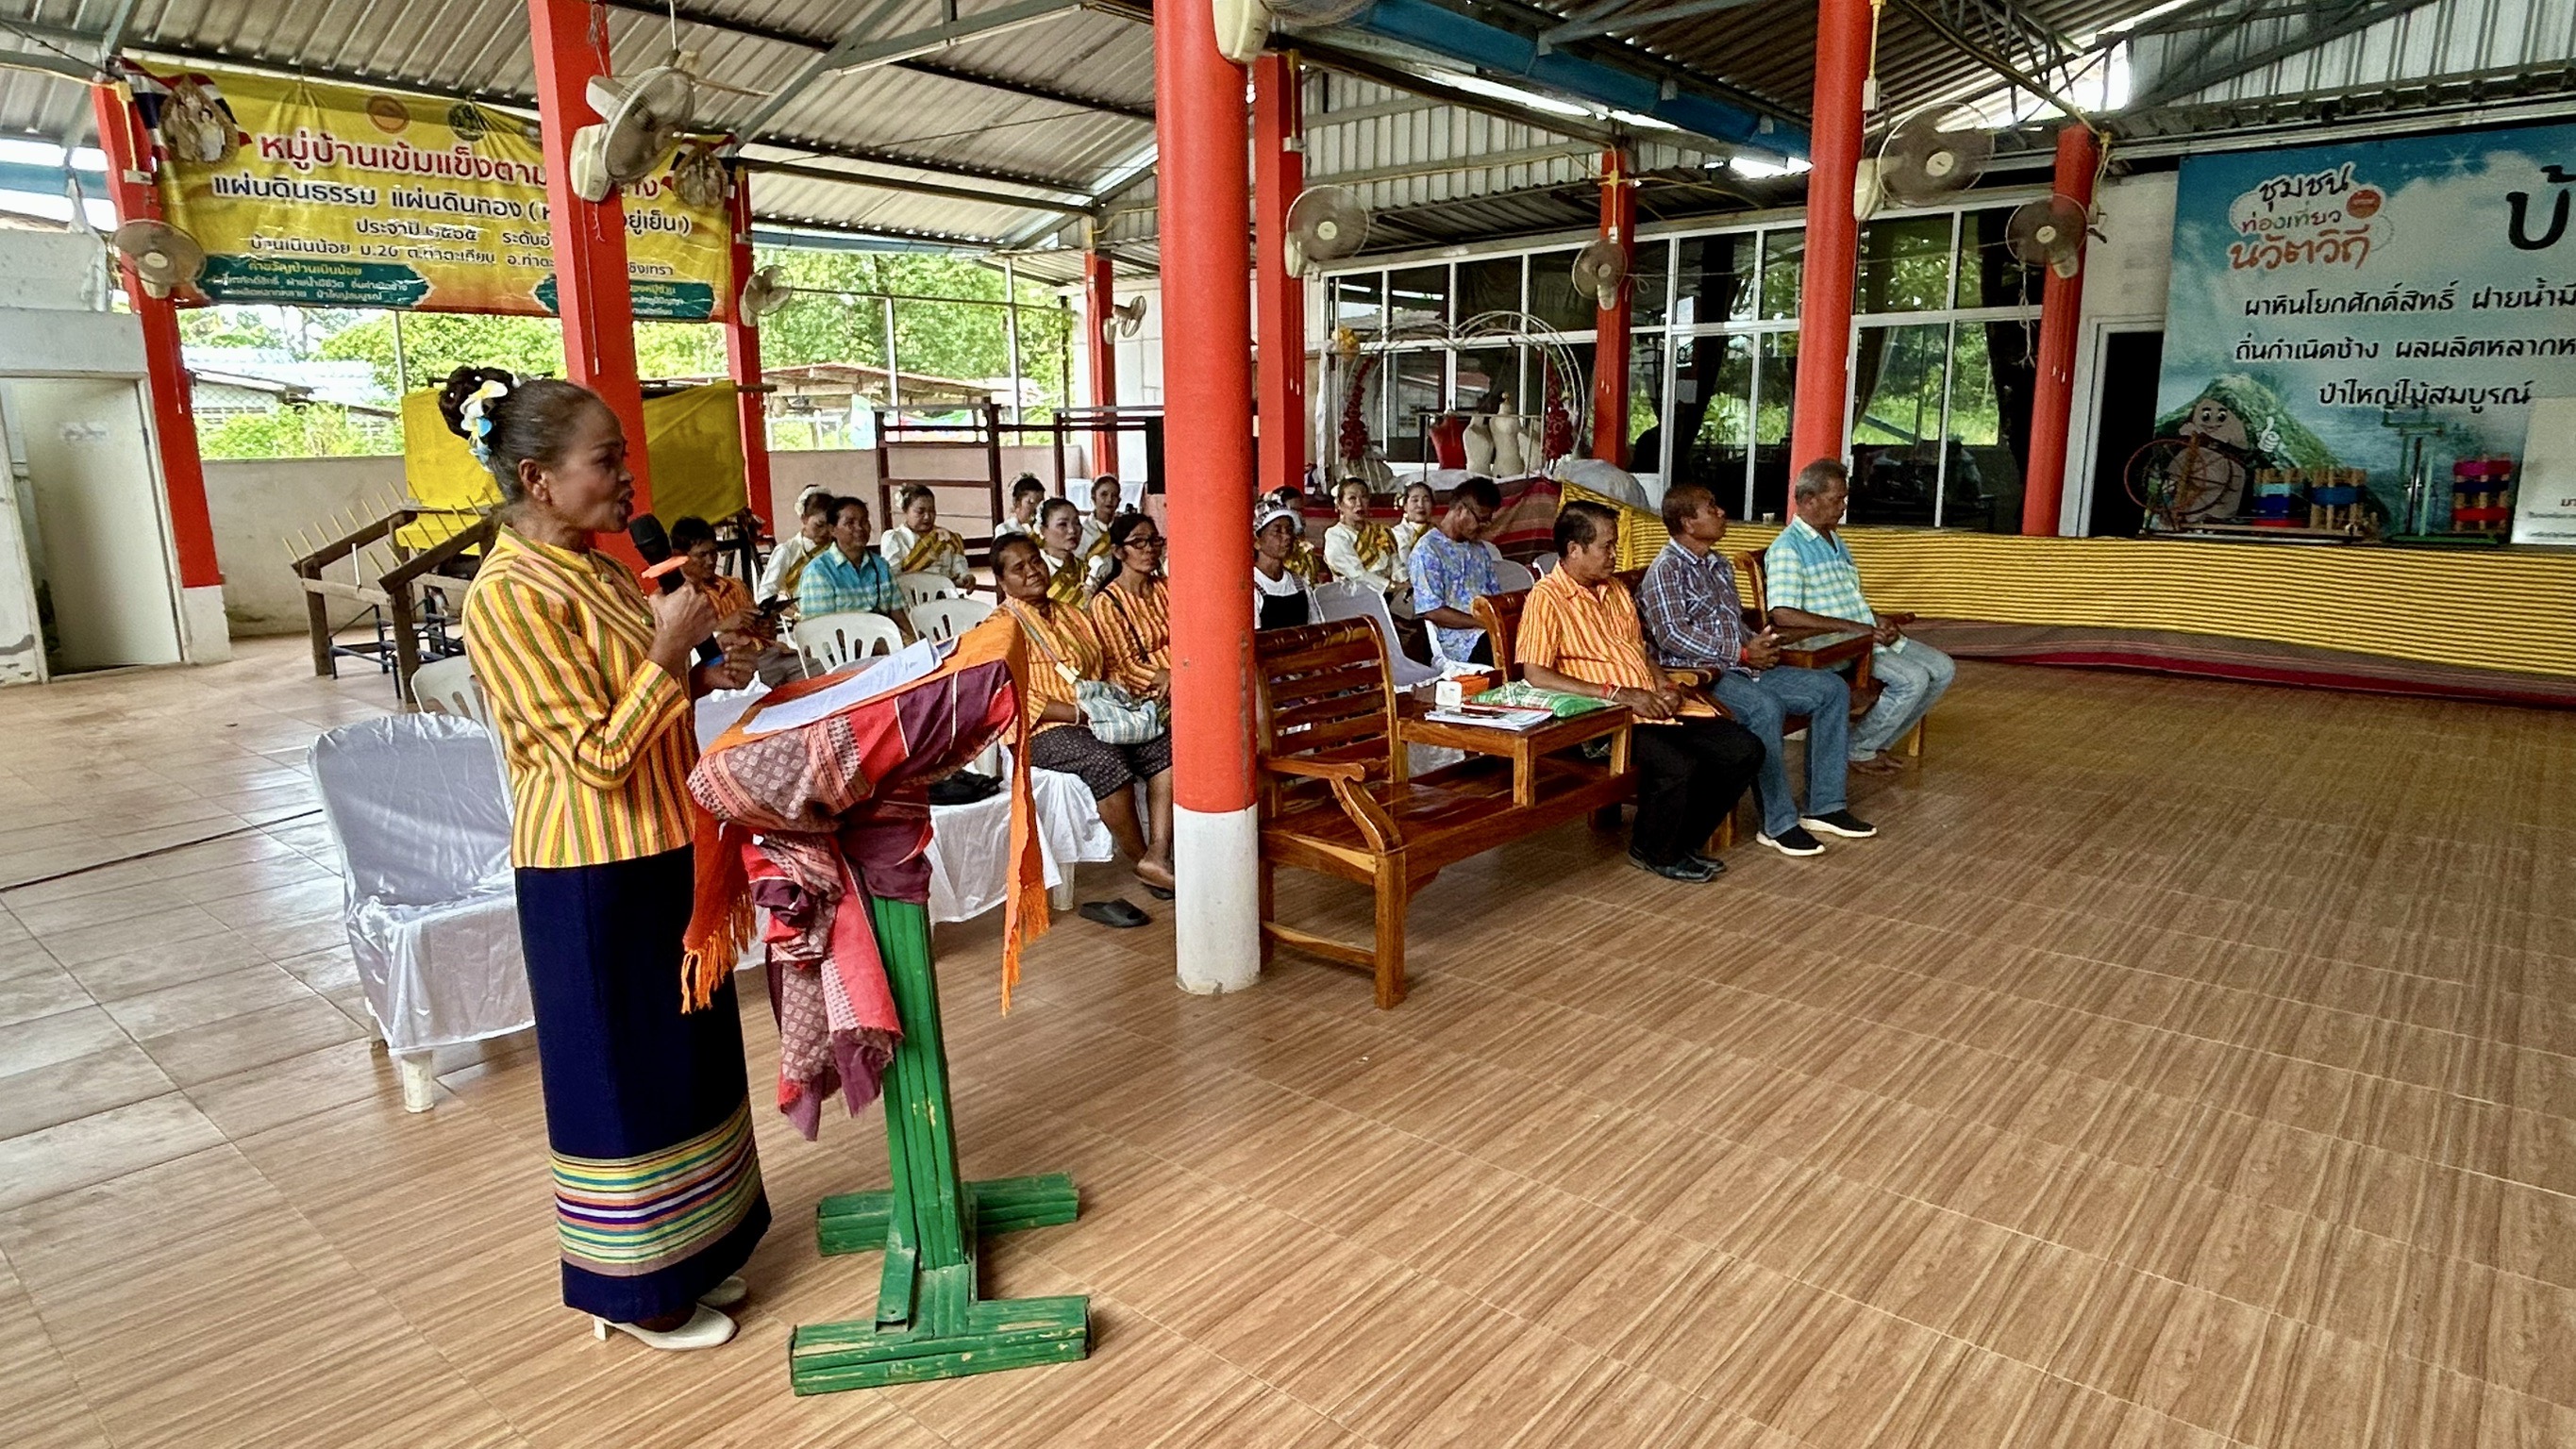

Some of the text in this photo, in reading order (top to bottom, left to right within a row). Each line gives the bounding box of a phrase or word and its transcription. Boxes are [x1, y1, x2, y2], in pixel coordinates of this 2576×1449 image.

[214, 173, 376, 206] แผ่นดินธรรม
[392, 187, 522, 219] แผ่นดินทอง
[2259, 164, 2350, 212] ชุมชน
[357, 217, 420, 235] ประจำปี
[2242, 199, 2342, 233] ท่องเที่ยว
[2245, 280, 2459, 316] ผาหินโยกศักดิ์สิทธิ์
[2235, 332, 2379, 360] ถิ่นกำเนิดช้าง
[2319, 378, 2535, 414] ป่าใหญ่ไม้สมบูรณ์
